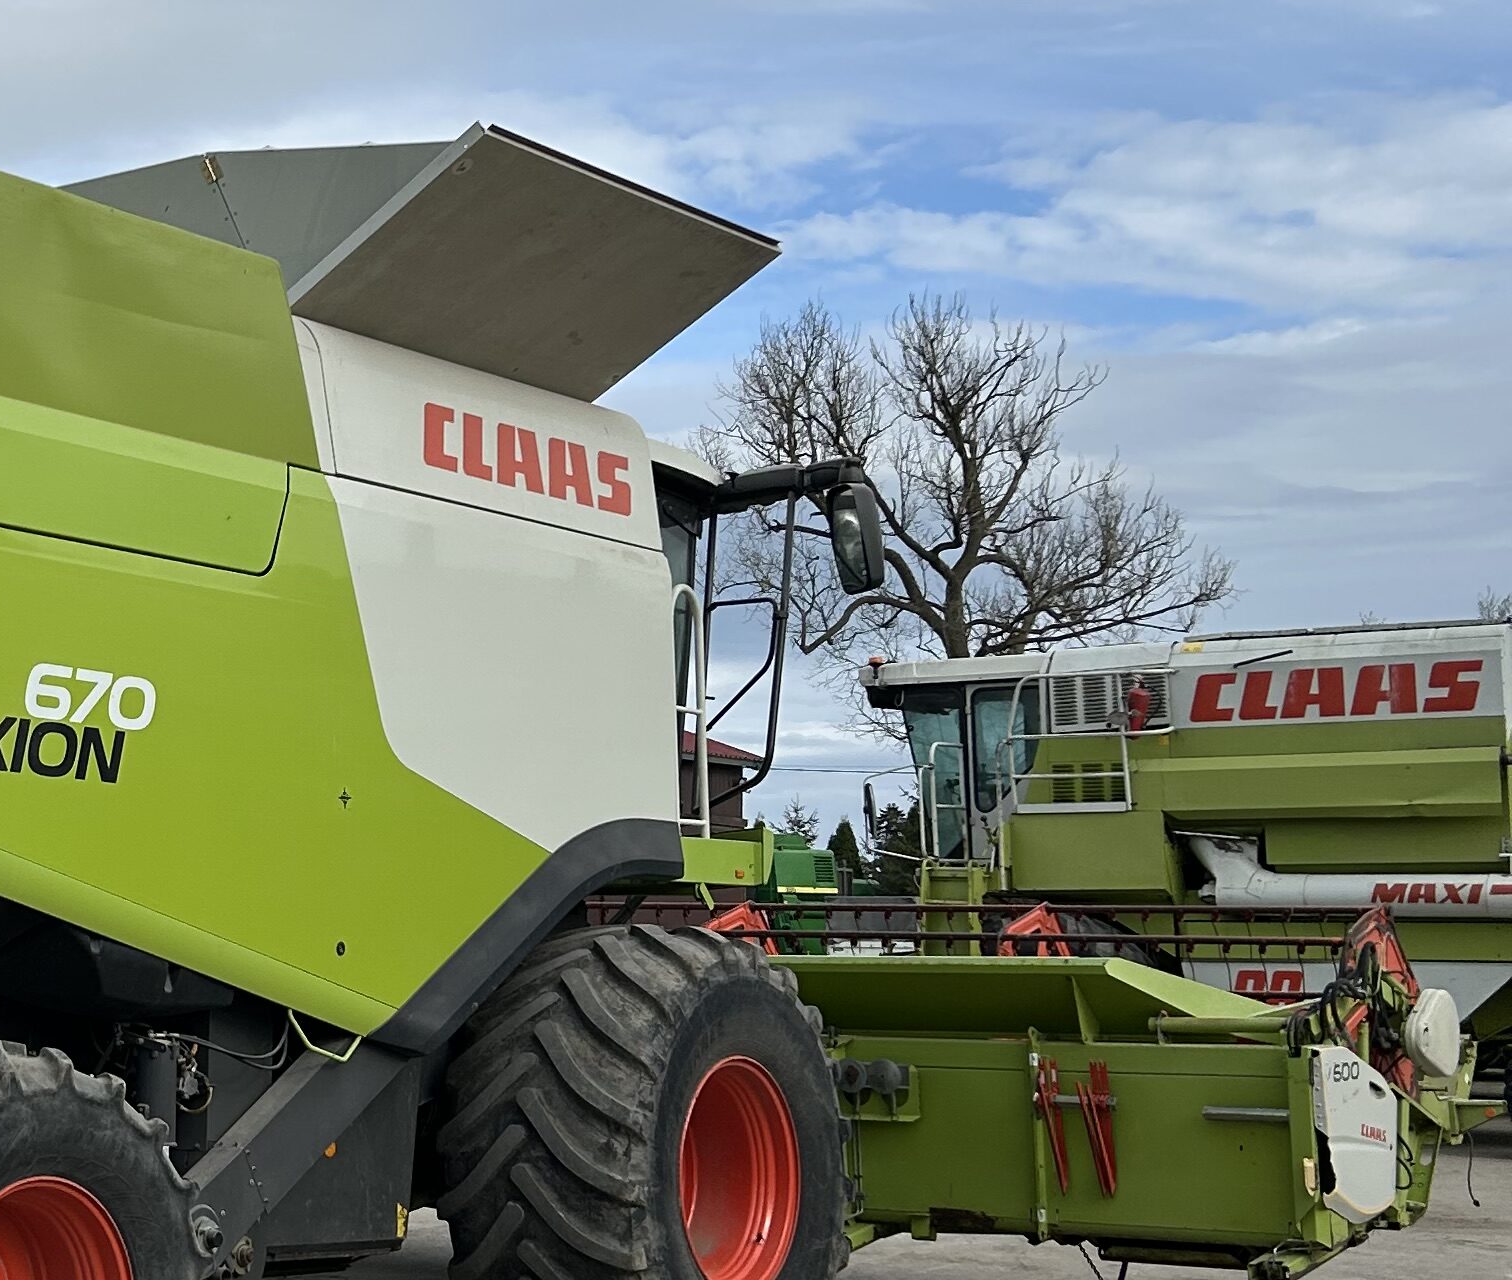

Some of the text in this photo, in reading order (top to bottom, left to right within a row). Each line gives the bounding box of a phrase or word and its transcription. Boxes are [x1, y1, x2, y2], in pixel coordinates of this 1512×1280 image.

[423, 402, 631, 516] CLAAS
[24, 663, 157, 731] 670
[1189, 659, 1484, 722] CLAAS
[1371, 883, 1484, 904] MAXI
[1361, 1123, 1387, 1142] CLAAS
